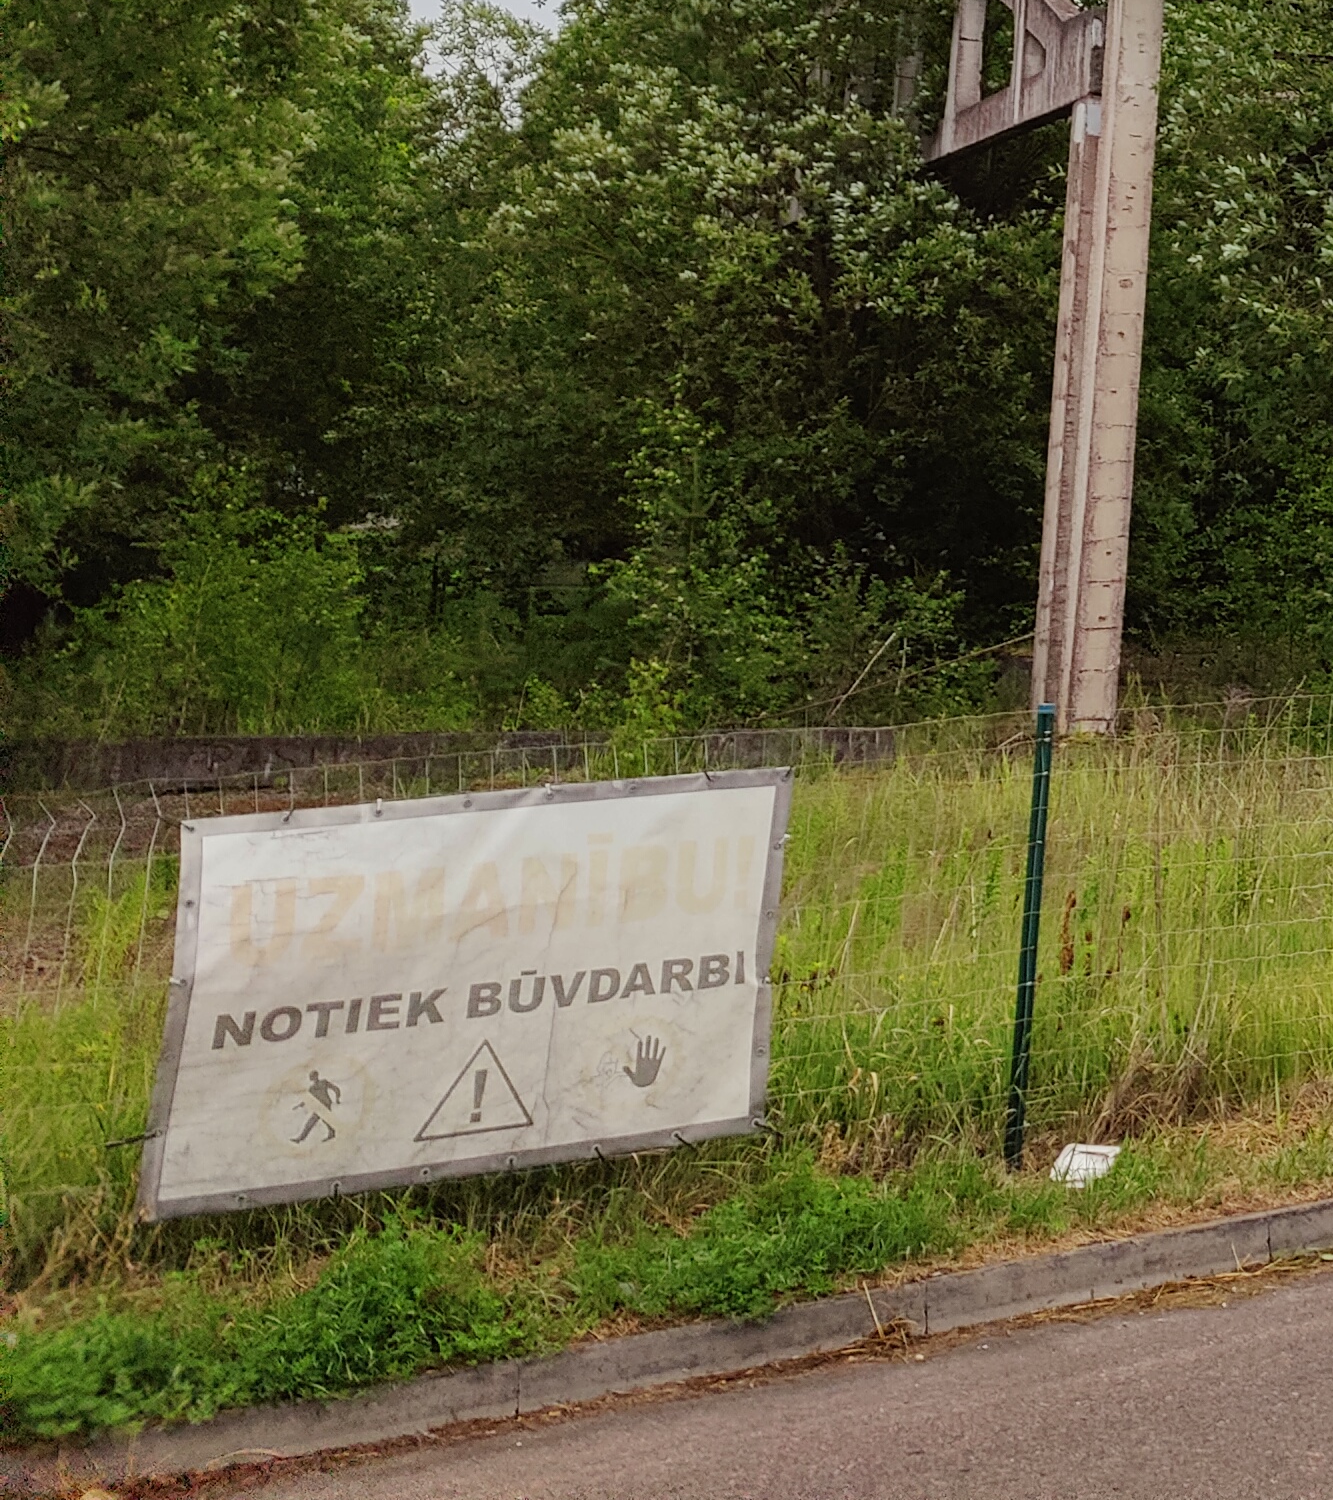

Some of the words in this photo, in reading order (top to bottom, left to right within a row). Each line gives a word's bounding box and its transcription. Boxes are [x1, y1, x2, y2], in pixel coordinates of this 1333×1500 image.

[228, 832, 757, 968] UZMANĪBU!
[212, 986, 447, 1050] NOTIEK
[466, 950, 745, 1020] BŪVDARBI
